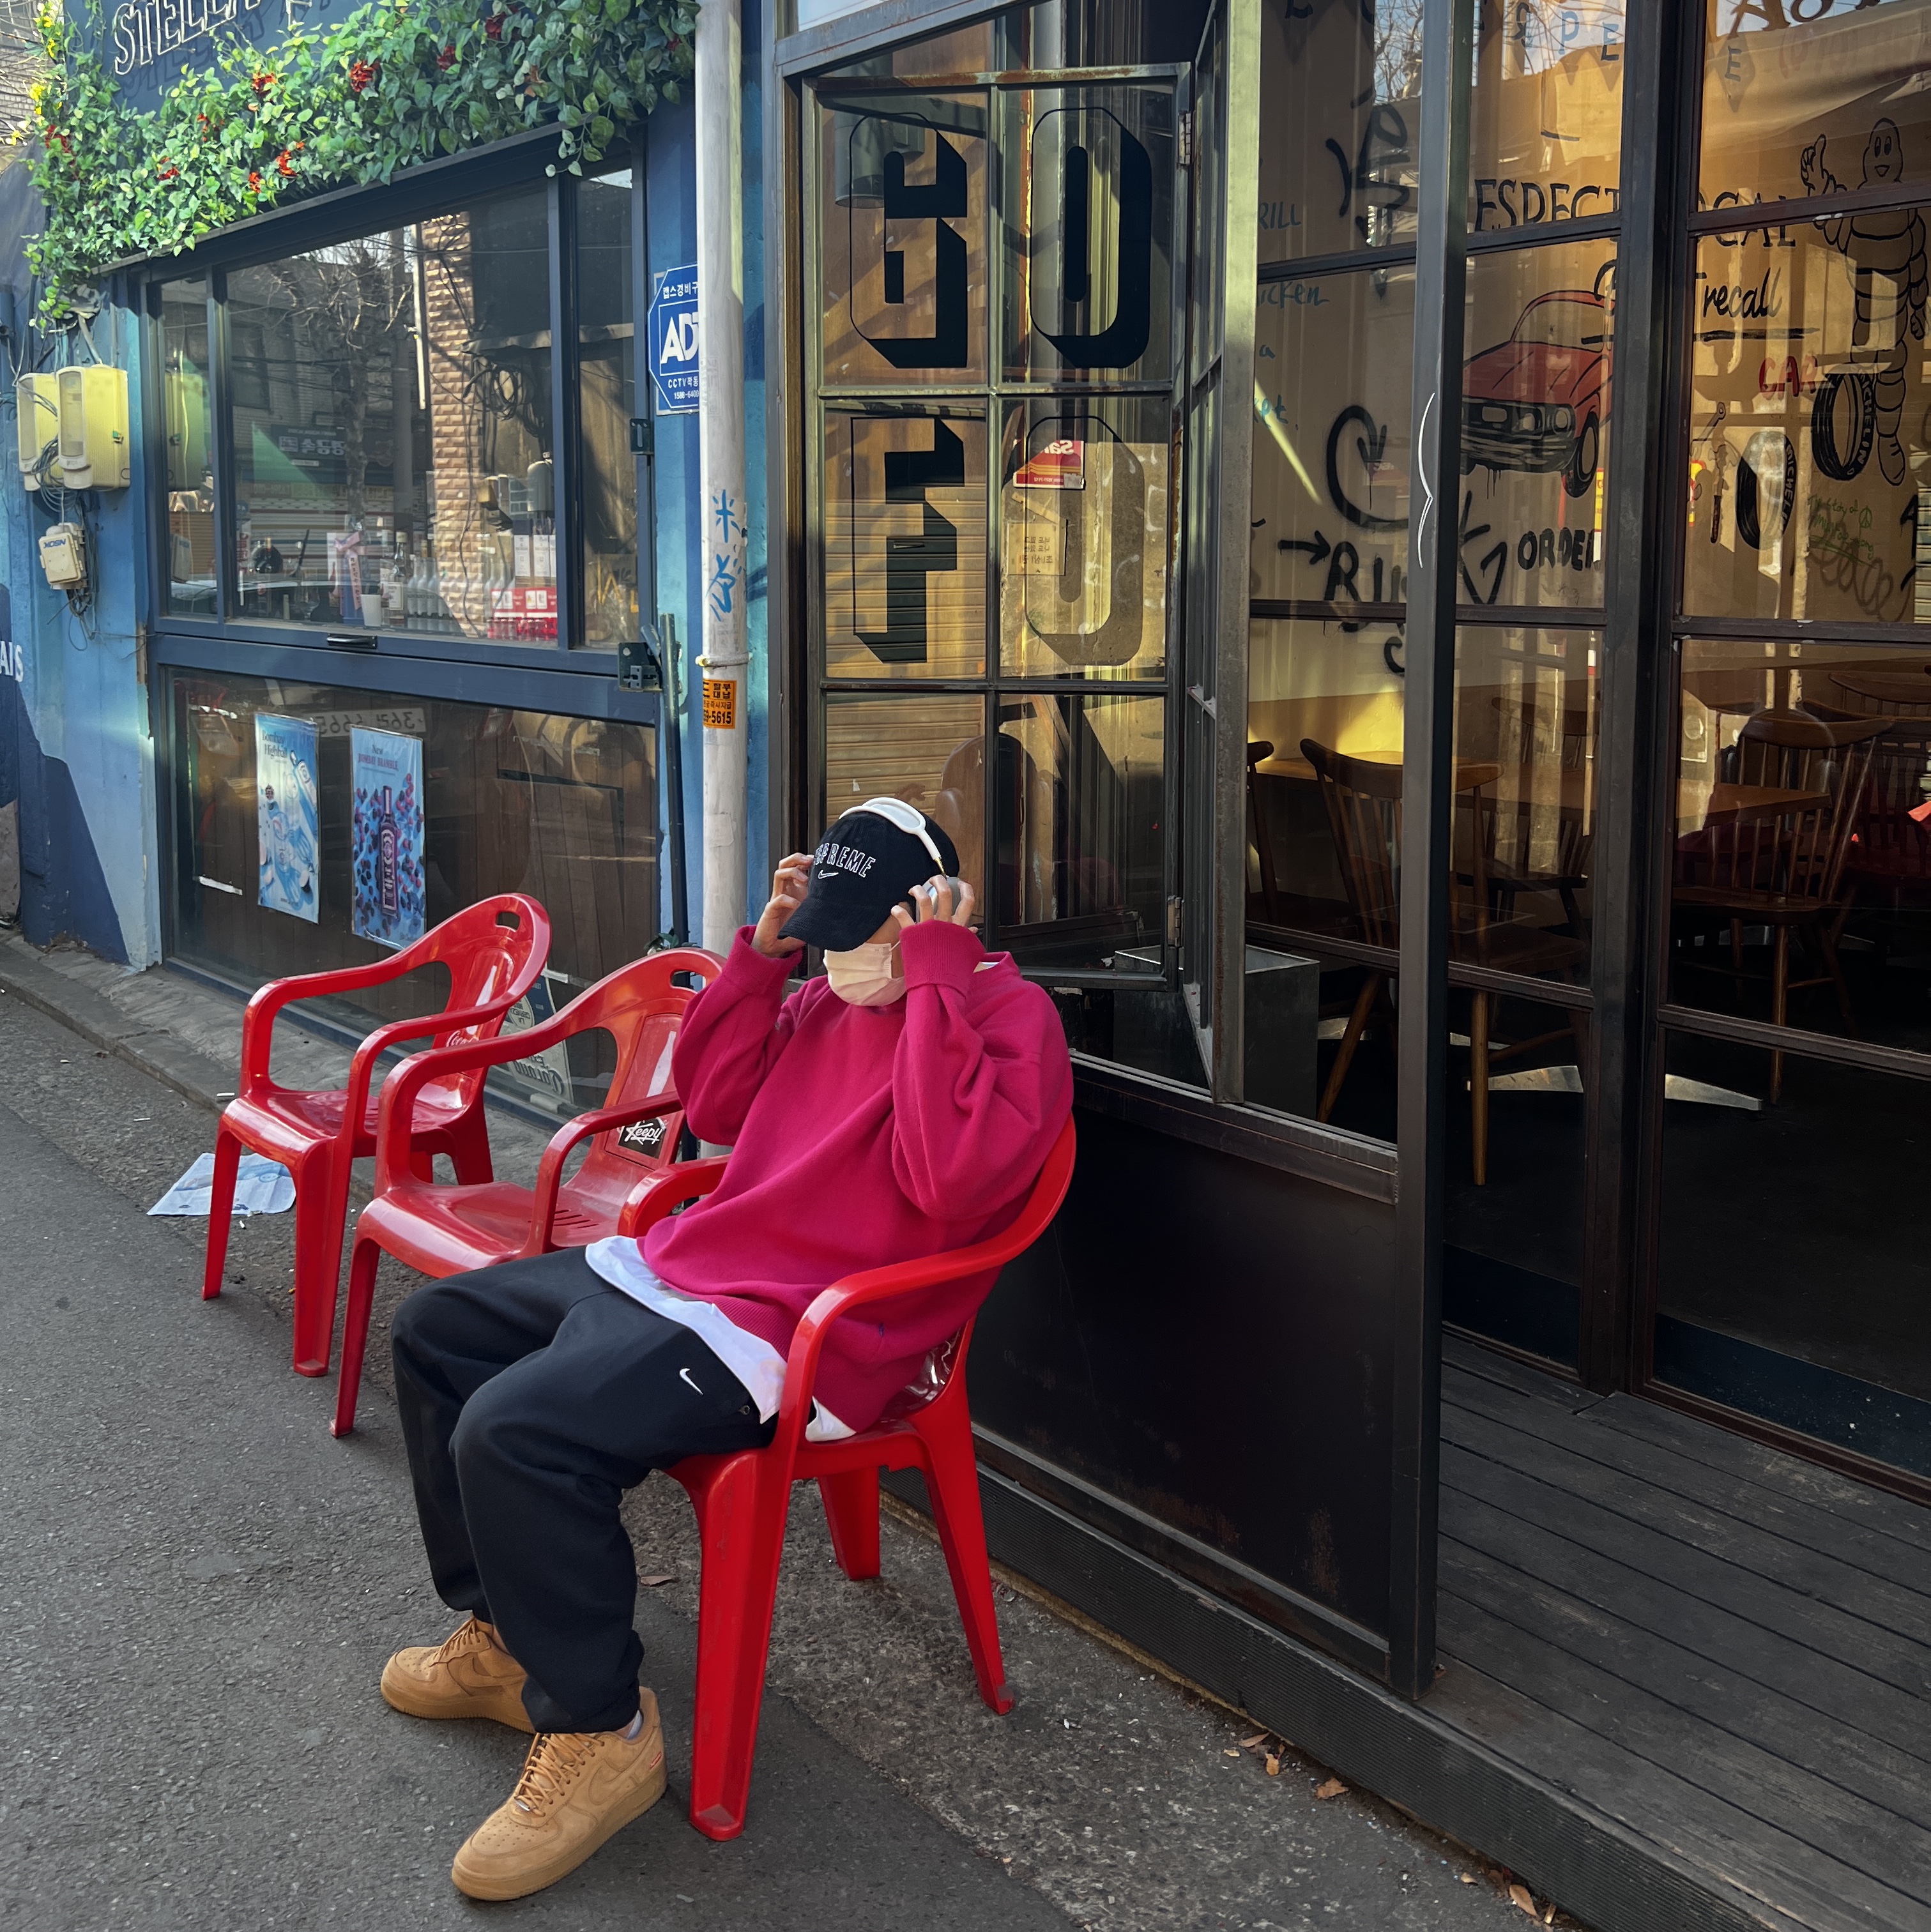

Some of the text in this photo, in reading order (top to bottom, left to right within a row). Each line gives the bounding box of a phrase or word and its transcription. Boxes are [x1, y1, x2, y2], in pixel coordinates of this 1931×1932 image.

[1256, 282, 1331, 309] icken
[1759, 355, 1818, 398] CAR
[623, 1121, 663, 1145] Keepy
